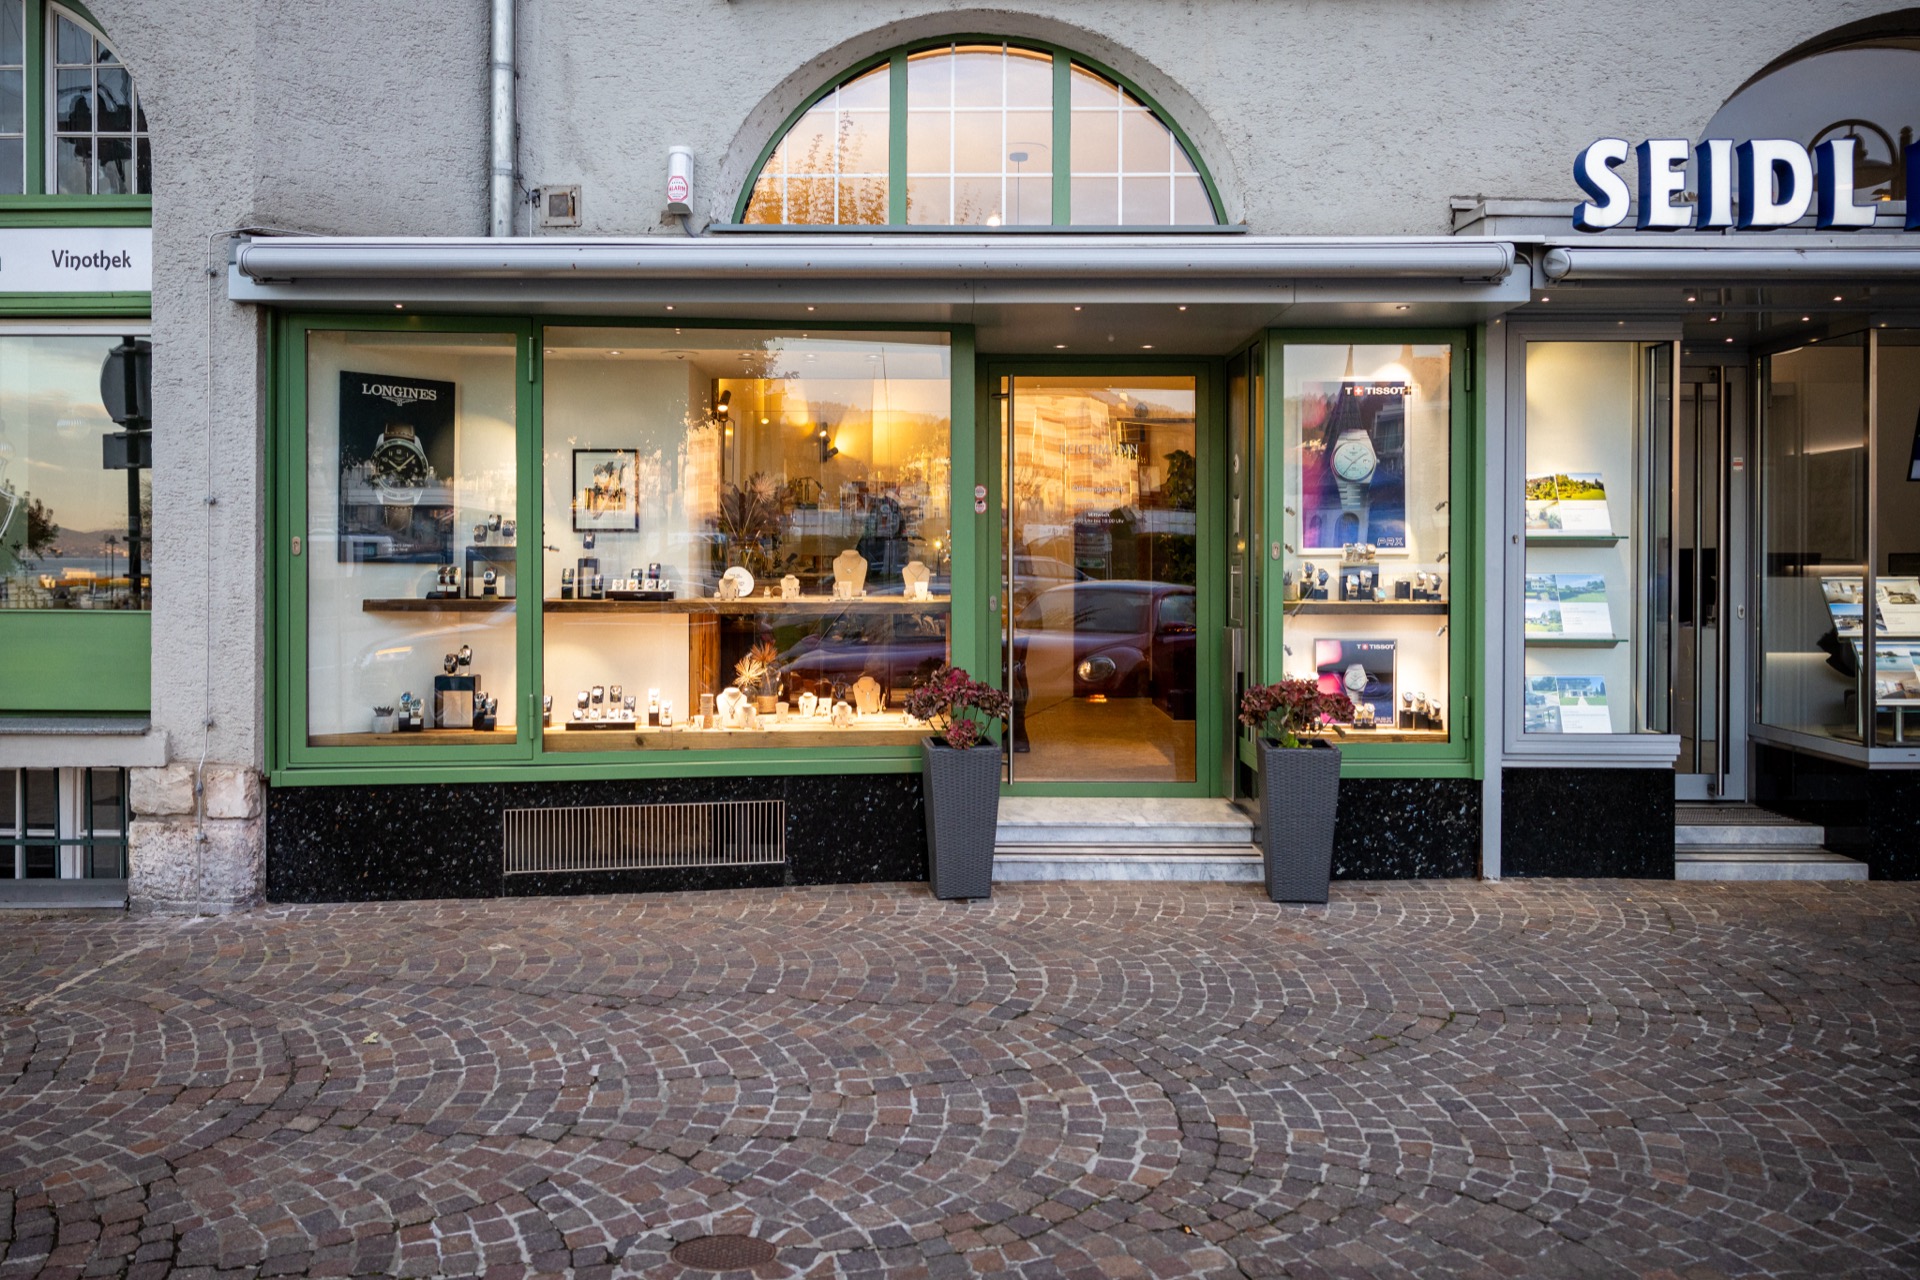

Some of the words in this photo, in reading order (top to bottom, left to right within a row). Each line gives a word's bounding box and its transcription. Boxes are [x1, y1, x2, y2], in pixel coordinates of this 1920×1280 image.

[1574, 138, 1878, 230] SEIDL
[51, 249, 132, 271] Vinothek
[362, 383, 437, 401] LONGINES
[1365, 387, 1405, 395] TISSOT
[1377, 537, 1404, 546] PRX
